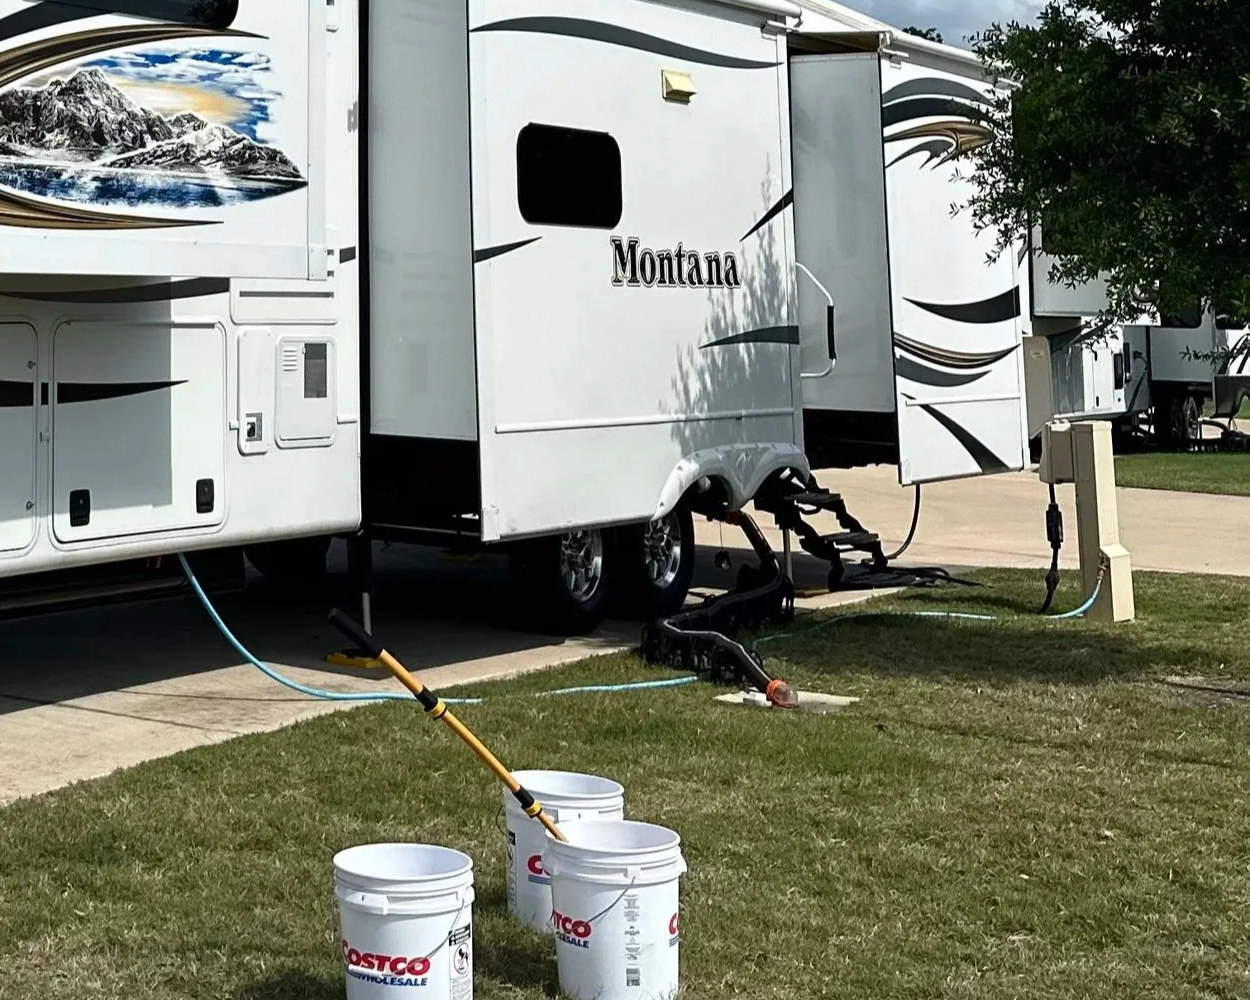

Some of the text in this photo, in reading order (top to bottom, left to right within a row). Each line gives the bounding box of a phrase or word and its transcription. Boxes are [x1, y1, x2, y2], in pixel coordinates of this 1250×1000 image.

[610, 236, 741, 289] Montana
[553, 910, 592, 938] TCO
[342, 938, 431, 976] COSTCO
[358, 972, 428, 987] WHOLESALE
